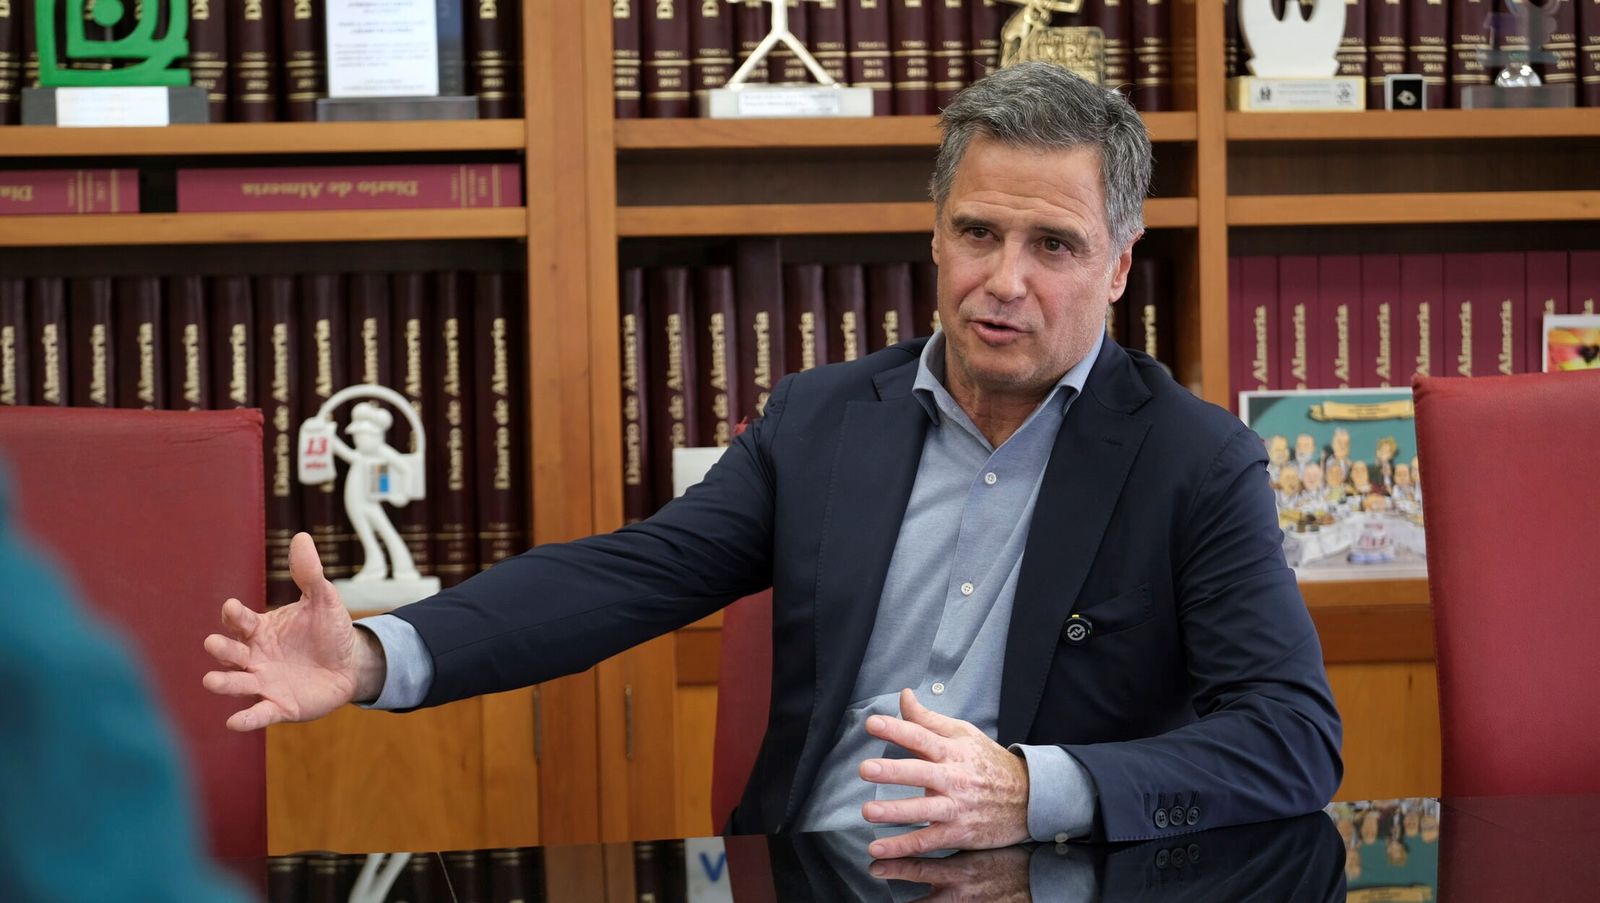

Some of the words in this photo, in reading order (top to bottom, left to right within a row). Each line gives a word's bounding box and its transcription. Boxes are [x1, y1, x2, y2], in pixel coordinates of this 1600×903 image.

[0, 185, 33, 202] Dia
[326, 181, 353, 198] de
[357, 180, 418, 197] Diario
[274, 405, 289, 432] de
[447, 400, 461, 425] de
[493, 399, 509, 425] de
[624, 395, 639, 421] de
[668, 395, 684, 420] de
[713, 393, 729, 419] de
[304, 437, 330, 456] 13
